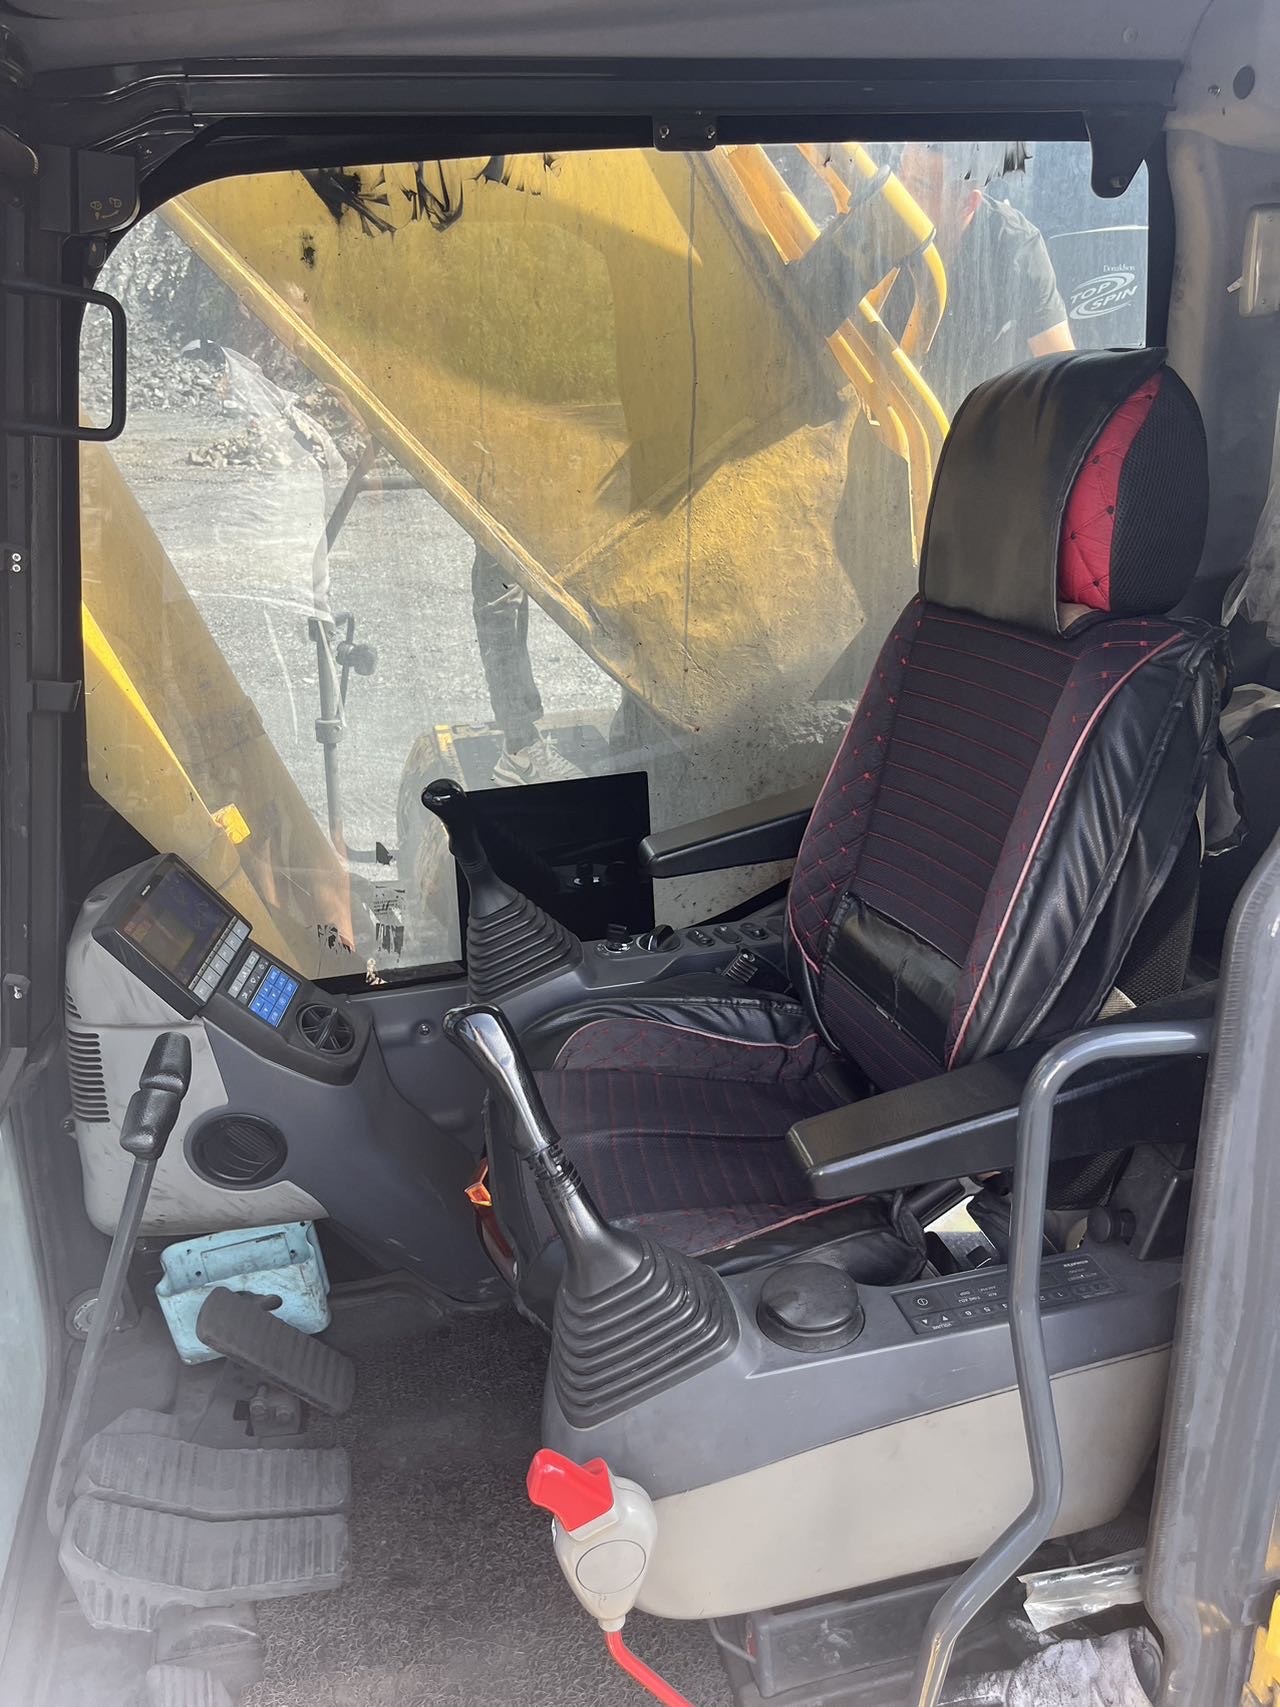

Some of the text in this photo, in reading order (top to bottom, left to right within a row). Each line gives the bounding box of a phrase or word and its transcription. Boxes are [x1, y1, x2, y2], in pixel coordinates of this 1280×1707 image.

[1103, 264, 1135, 272] Donaldson
[1070, 282, 1112, 304] TOP
[1091, 285, 1138, 310] SPIN
